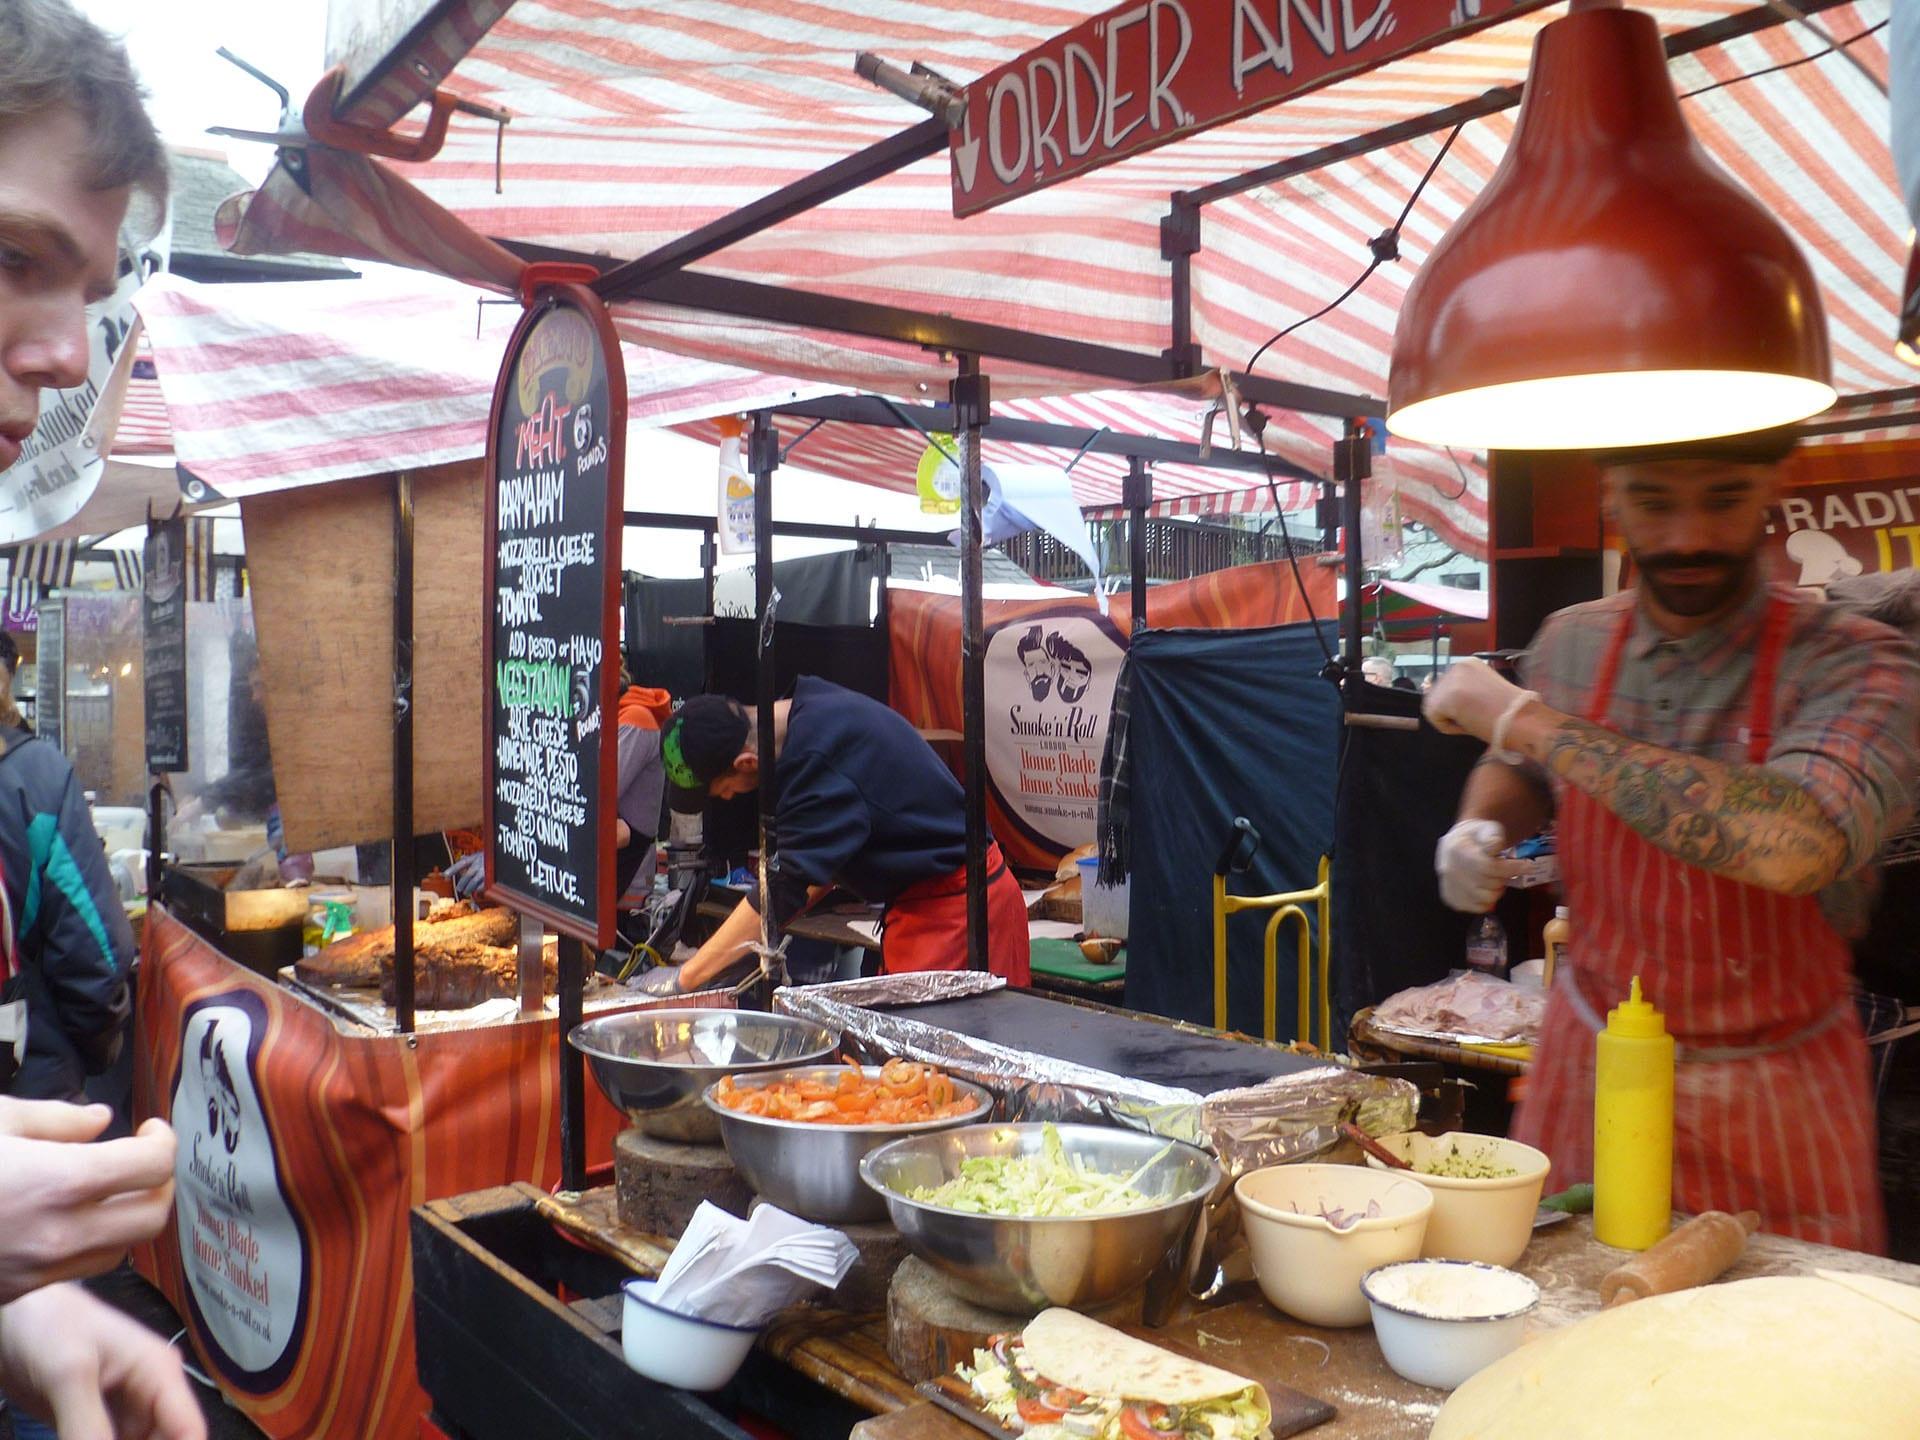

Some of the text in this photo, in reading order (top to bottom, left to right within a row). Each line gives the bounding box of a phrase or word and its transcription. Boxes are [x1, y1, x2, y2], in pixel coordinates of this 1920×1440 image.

[987, 0, 1193, 184] ORDER
[577, 435, 607, 477] POUNDS
[500, 532, 595, 569] MOZZARELLA CHEESE
[522, 561, 565, 597] ROCKET
[508, 631, 526, 658] ADD
[570, 634, 602, 671] MAYO
[509, 704, 569, 750] BRIE CHEESE
[499, 734, 578, 783] HOMEMADE PESTO
[1021, 746, 1096, 775] Home Made
[499, 778, 586, 827] MOZZARELLA CHEESE
[1019, 771, 1053, 795] Home
[499, 824, 537, 862] TOMATO
[516, 806, 569, 853] RED ONION
[224, 1249, 269, 1307] Smoked
